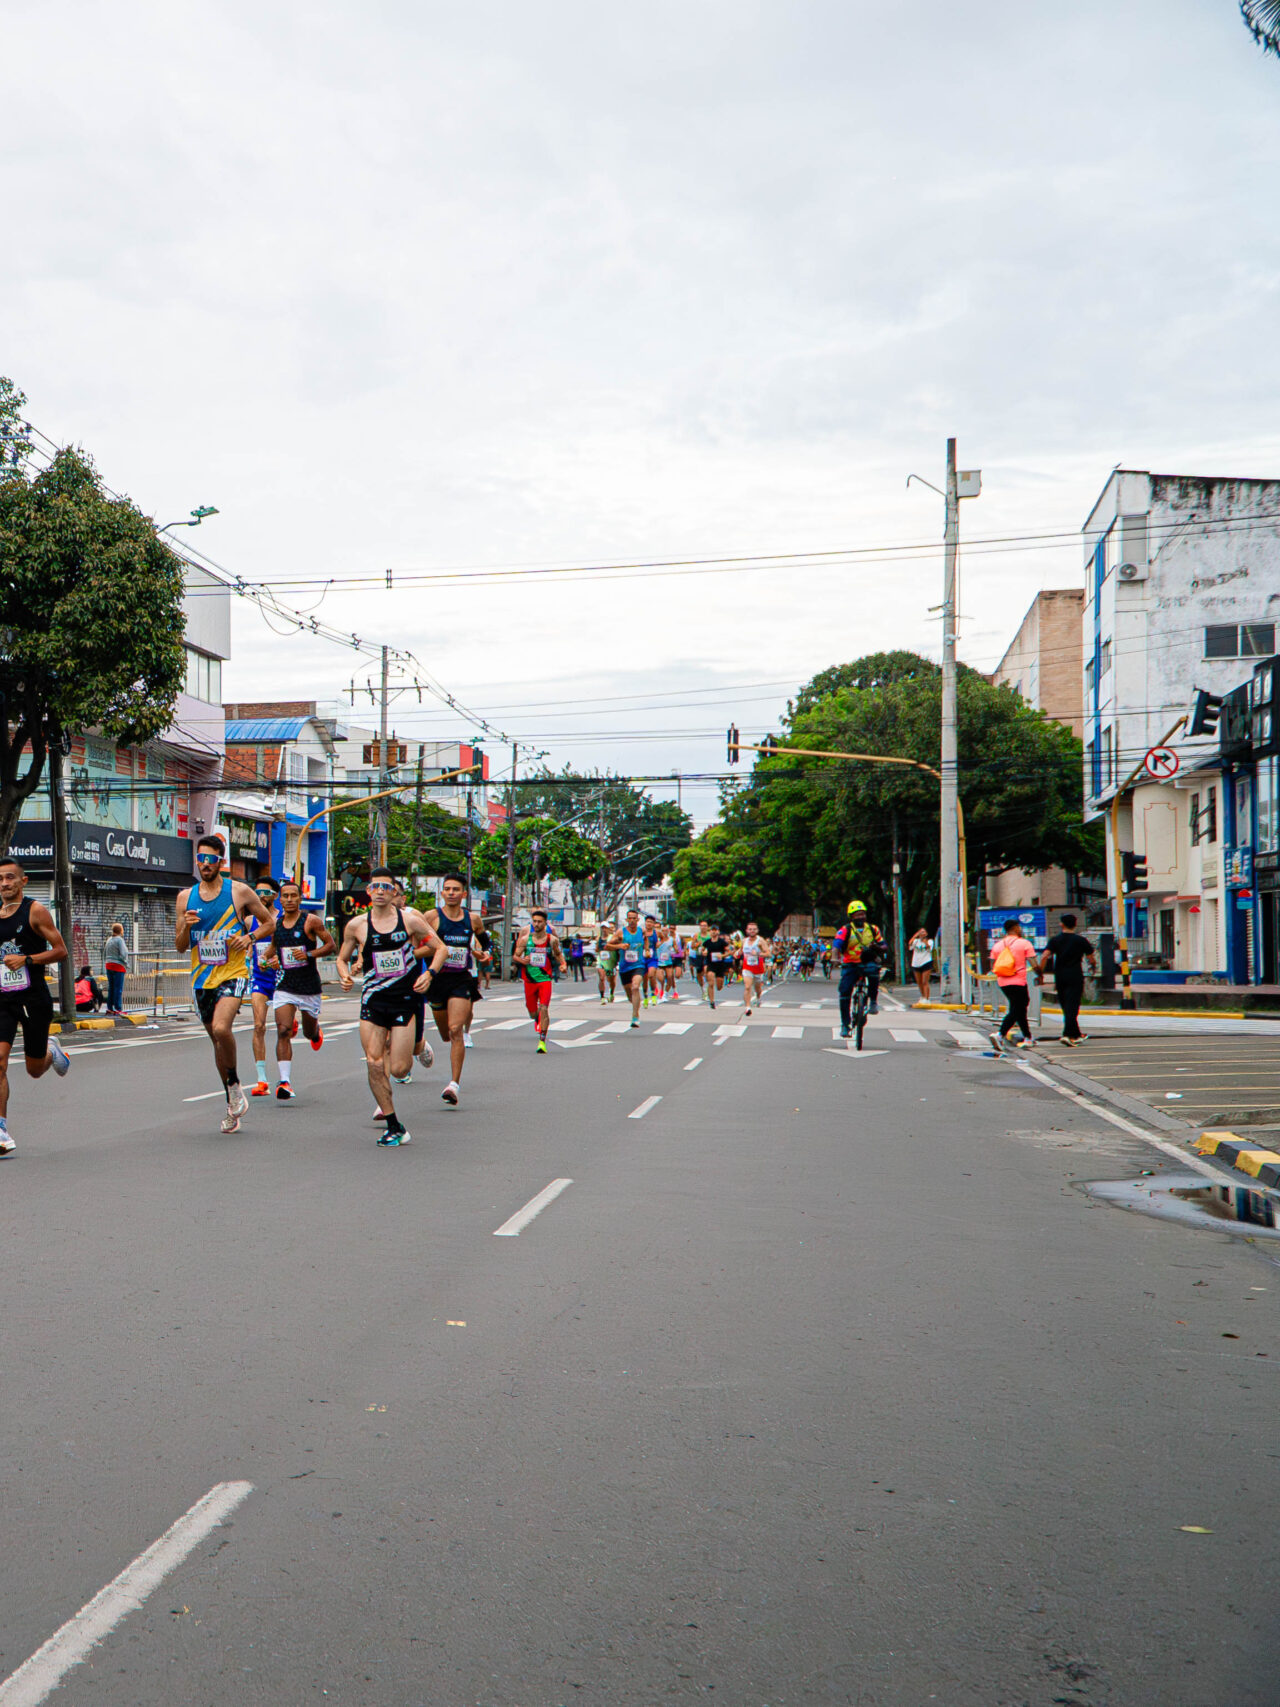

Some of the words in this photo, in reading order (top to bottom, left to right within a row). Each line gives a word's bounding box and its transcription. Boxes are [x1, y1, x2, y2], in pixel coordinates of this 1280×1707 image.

[105, 832, 125, 857] Casa
[201, 948, 226, 957] AMAYA
[380, 957, 400, 968] 4550
[4, 970, 23, 981] 4705
